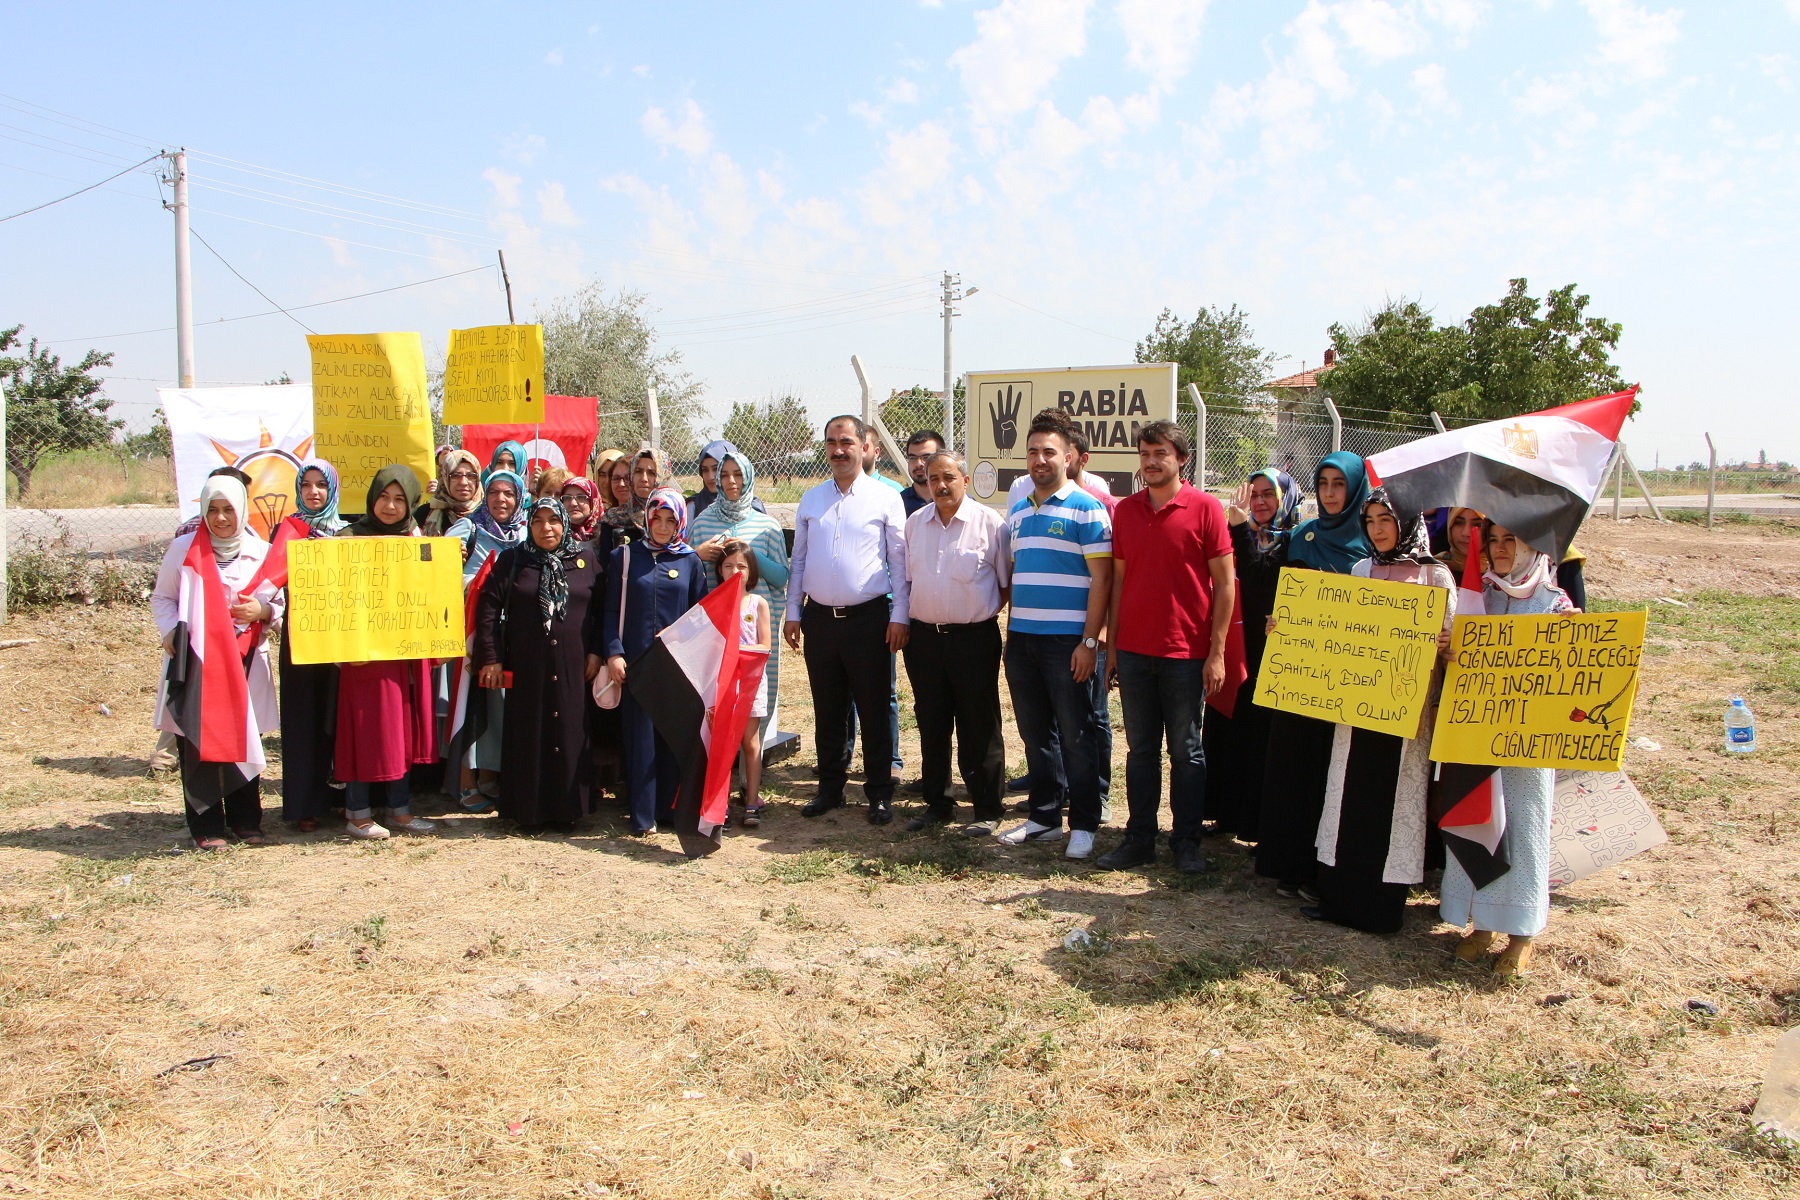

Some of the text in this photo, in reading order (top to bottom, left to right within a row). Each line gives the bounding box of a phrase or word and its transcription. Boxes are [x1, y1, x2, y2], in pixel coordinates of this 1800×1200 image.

[309, 341, 387, 357] MAZLUMLARIN
[313, 361, 392, 378] ZALİMLERDEN
[447, 370, 471, 387] SEN
[1057, 382, 1149, 417] RABİA
[314, 430, 389, 448] ZULMÜNDEN
[294, 542, 325, 565] BİR
[294, 566, 389, 590] GÜLDÜRMEK
[396, 590, 428, 607] ONU
[1344, 621, 1380, 637] HAKKI
[1389, 627, 1437, 644] AYAKTA
[1461, 618, 1619, 647] BELKİ HEPİMİZ
[1323, 639, 1391, 663] ADALETLE
[1339, 669, 1383, 687] EDEN
[1500, 671, 1603, 697] İNŞALLAH
[1356, 702, 1408, 722] OLUN
